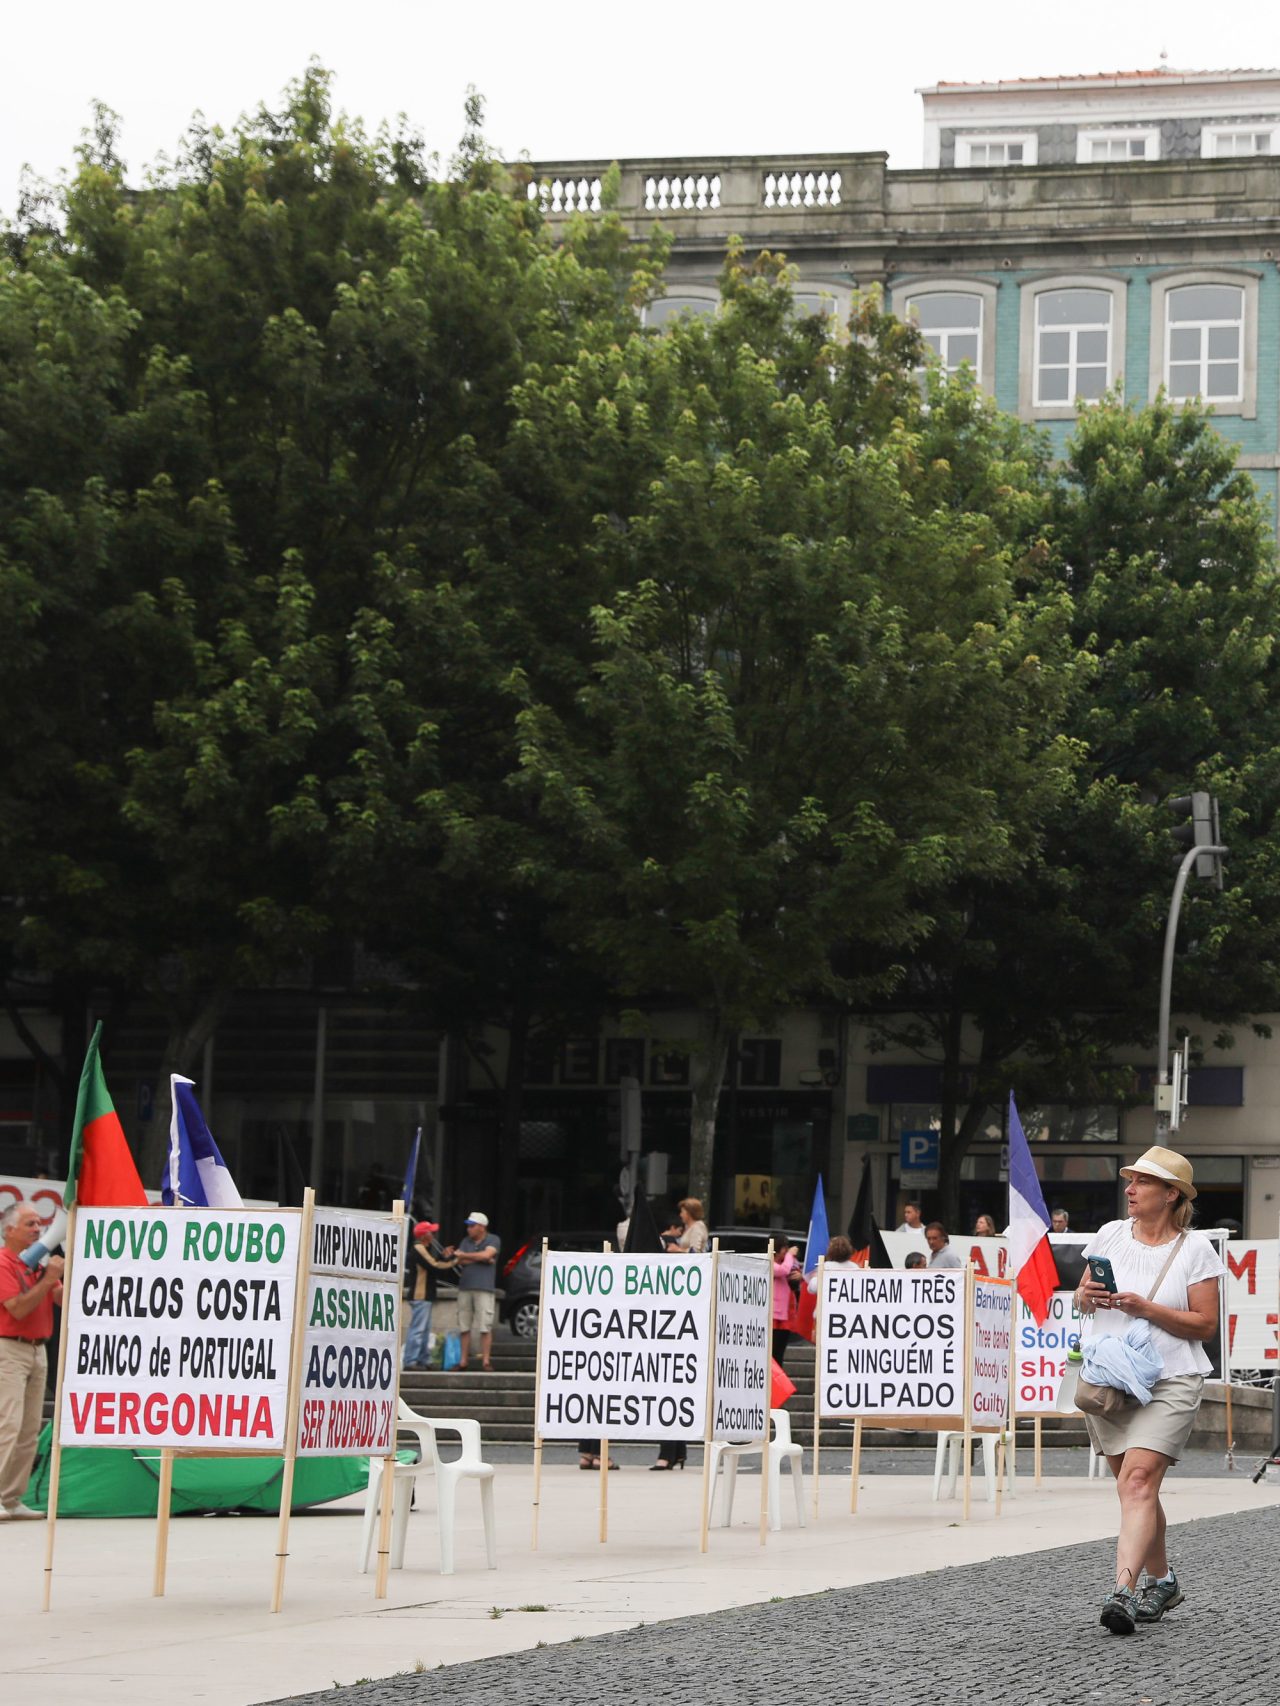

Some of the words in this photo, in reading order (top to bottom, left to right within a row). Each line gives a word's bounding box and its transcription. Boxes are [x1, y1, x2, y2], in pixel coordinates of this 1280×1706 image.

[909, 1136, 929, 1164] P
[84, 1219, 167, 1261] NOVO
[183, 1220, 286, 1264] ROUBO
[313, 1223, 398, 1273] IMPUNIDADE
[551, 1265, 614, 1296] NOVO
[624, 1265, 702, 1296] BANCO
[719, 1271, 741, 1305] NOVO
[743, 1276, 768, 1308] BANCO
[828, 1278, 902, 1304] FALIRAM
[911, 1274, 956, 1304] TRÊS
[82, 1275, 184, 1319] CARLOS
[197, 1278, 282, 1321] COSTA
[309, 1287, 396, 1333] ASSINAR
[975, 1287, 1012, 1318] Bankrupt
[550, 1308, 699, 1341] VIGARIZA
[718, 1314, 731, 1345] We
[732, 1321, 743, 1347] are
[745, 1318, 766, 1348] stolen
[827, 1313, 955, 1340] BANCOS
[975, 1322, 992, 1345] Three
[993, 1326, 1010, 1349] banks
[77, 1333, 142, 1378] BANCO
[149, 1336, 171, 1378] de
[179, 1337, 277, 1381] PORTUGAL
[305, 1344, 393, 1391] ACORDO
[547, 1350, 697, 1384] DEPOSITANTES
[717, 1357, 740, 1390] With
[743, 1359, 766, 1391] fake
[827, 1348, 838, 1374] E
[847, 1341, 933, 1375] NINGUÉM
[942, 1340, 955, 1374] É
[973, 1355, 1000, 1387] Nobody
[1000, 1359, 1008, 1380] is
[545, 1392, 696, 1428] HONESTOS
[826, 1382, 955, 1409] CULPADO
[972, 1391, 1007, 1419] Guilty
[1020, 1385, 1054, 1402] on
[70, 1391, 274, 1438] VERGONHA
[300, 1398, 324, 1450] SER
[327, 1399, 378, 1449] ROUBADO
[377, 1399, 394, 1448] 2X
[716, 1400, 764, 1432] Accounts
